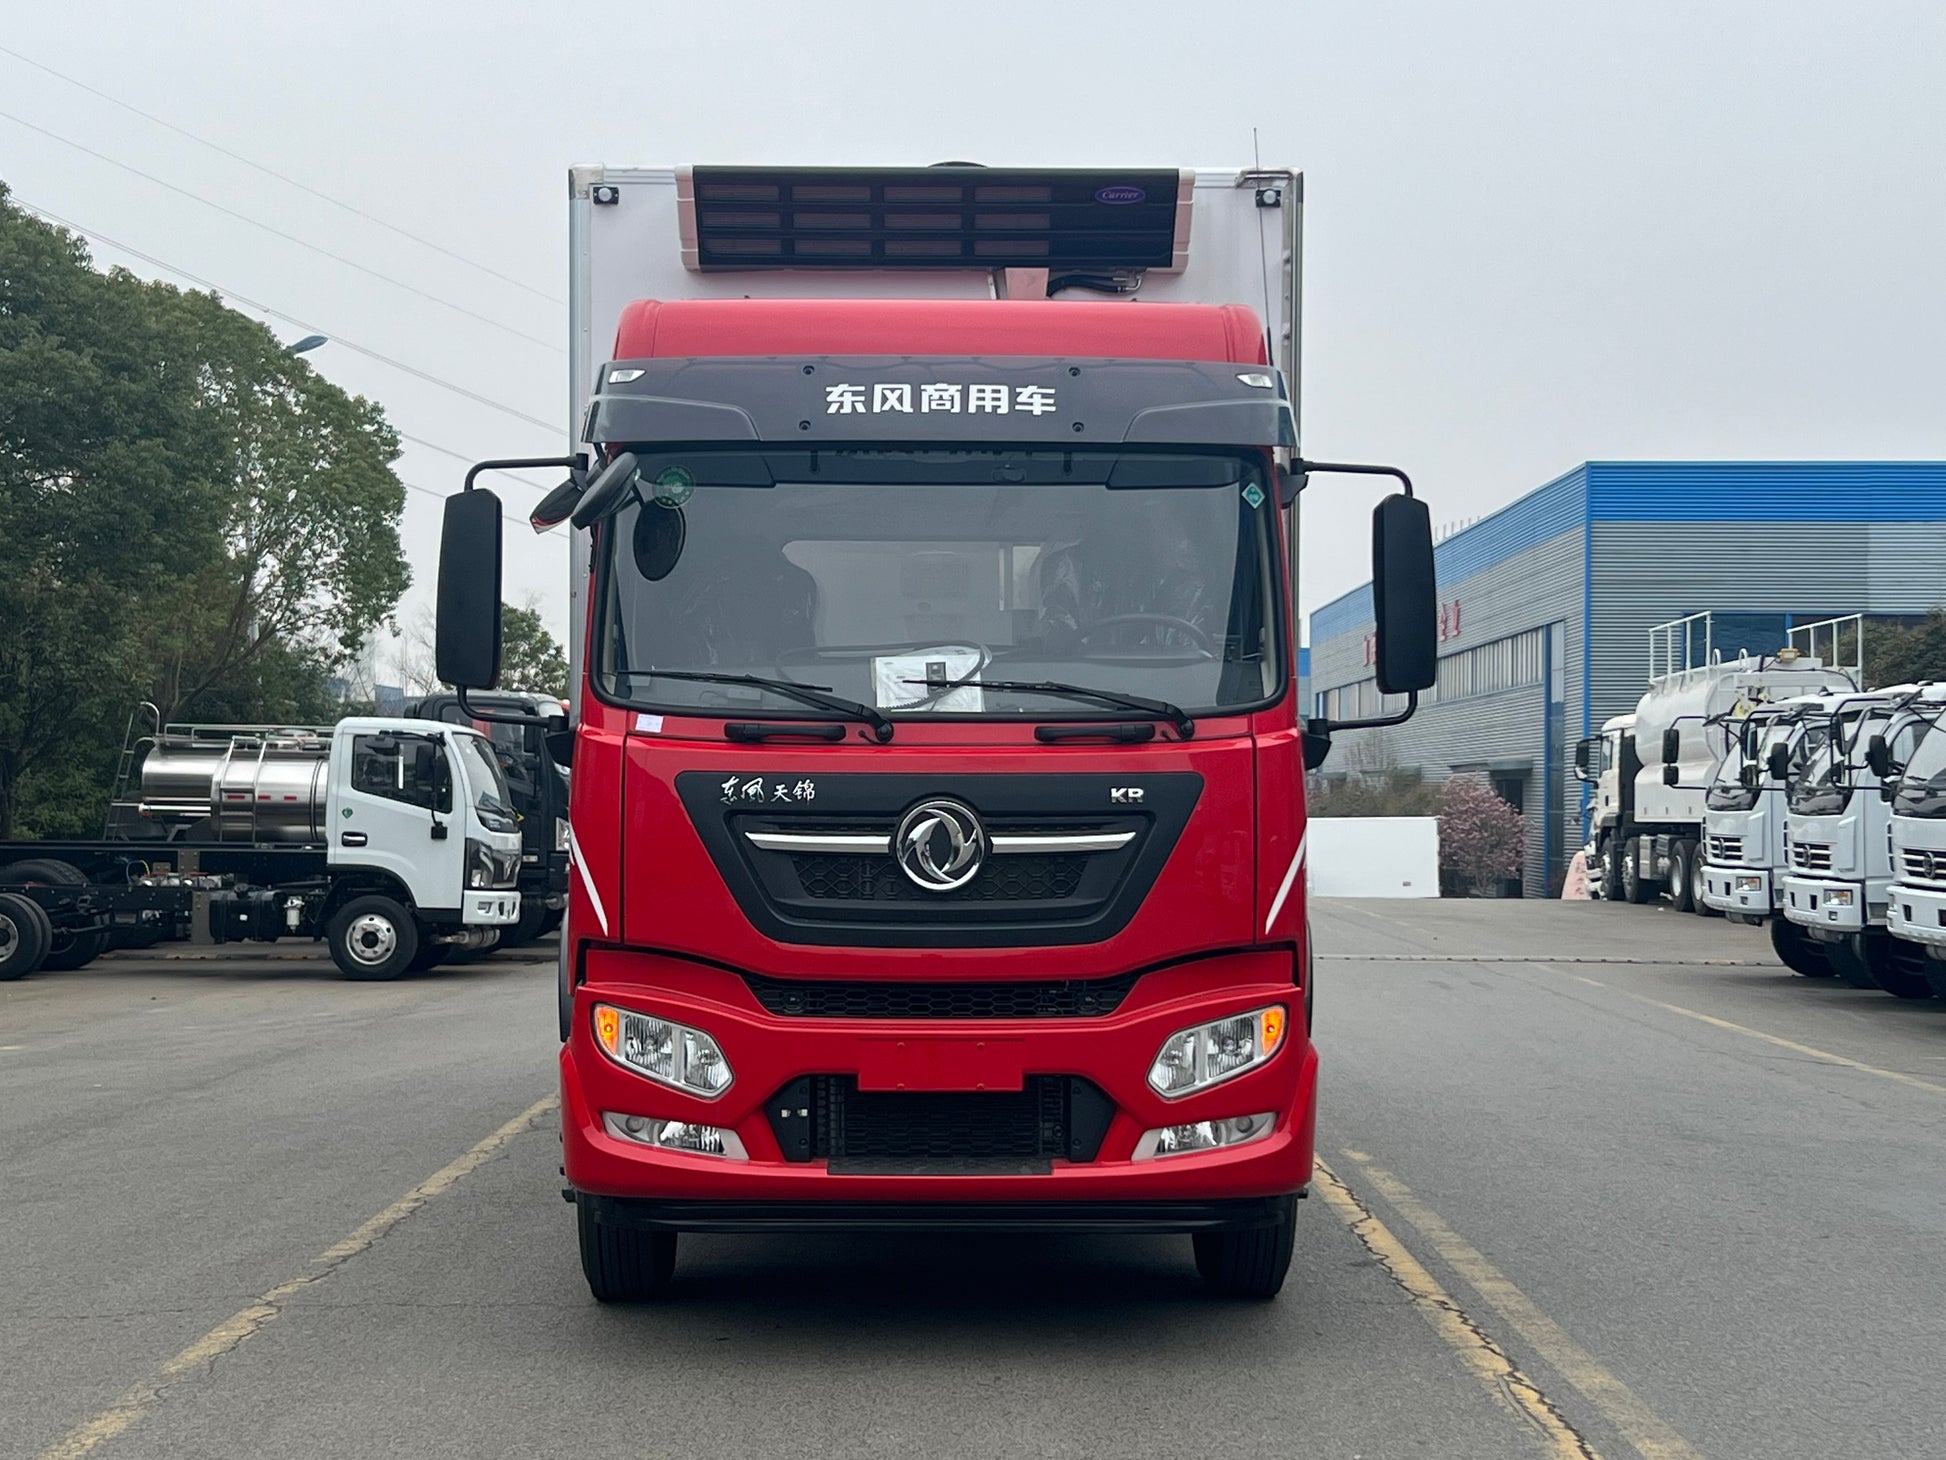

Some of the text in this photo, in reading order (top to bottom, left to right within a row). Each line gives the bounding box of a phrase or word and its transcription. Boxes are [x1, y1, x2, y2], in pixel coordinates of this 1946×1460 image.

[825, 383, 1057, 416] 东风商用车
[1110, 787, 1144, 803] KR
